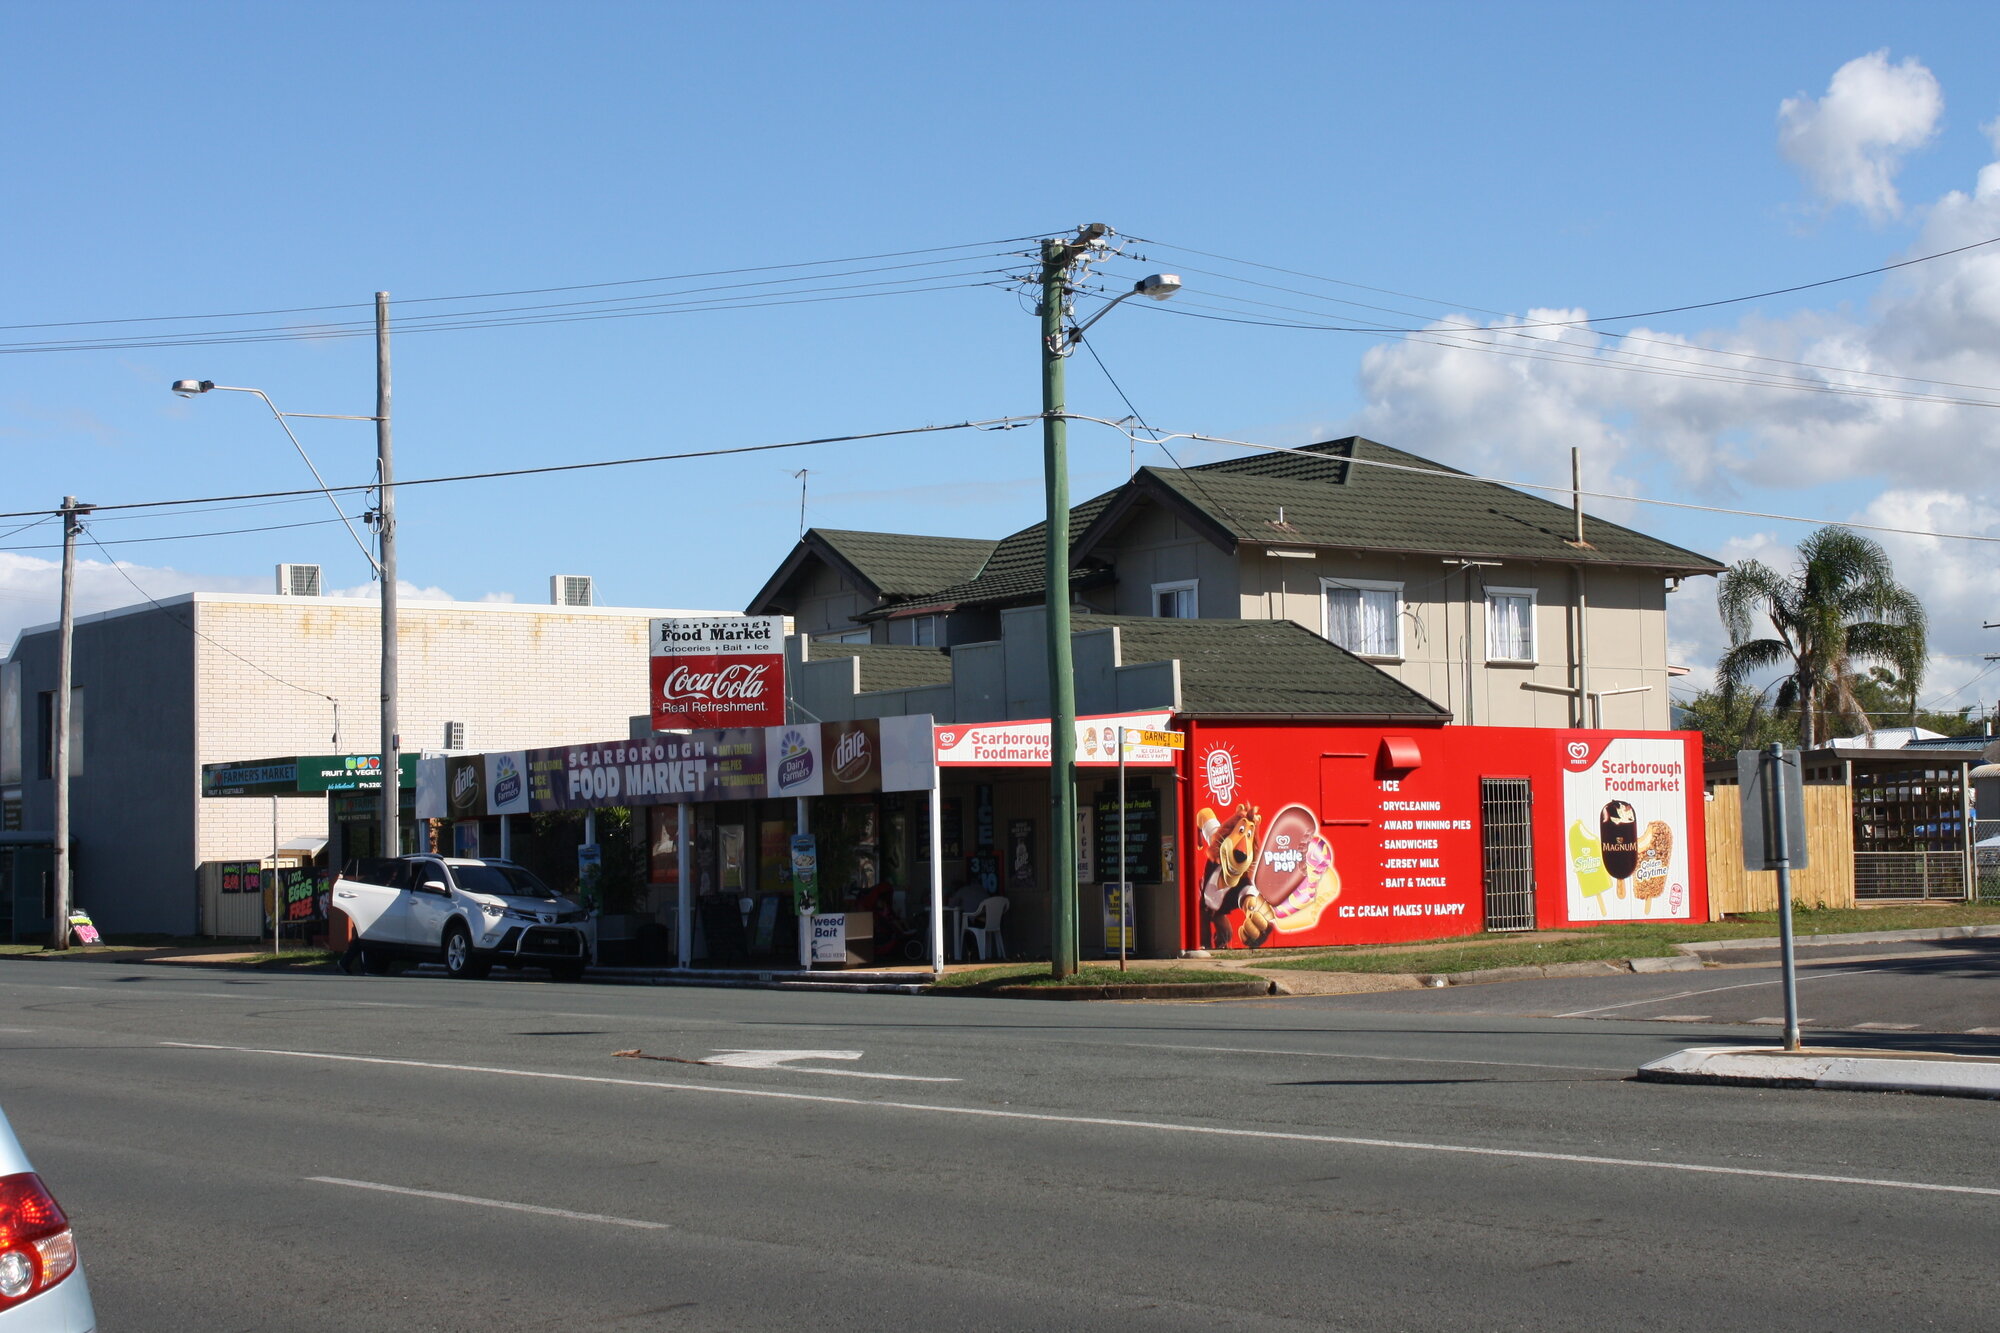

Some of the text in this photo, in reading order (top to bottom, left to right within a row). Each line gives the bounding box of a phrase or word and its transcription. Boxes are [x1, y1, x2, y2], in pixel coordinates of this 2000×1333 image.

[662, 620, 771, 629] Scarborough
[661, 628, 771, 641] Food Market
[723, 644, 742, 652] Bait
[754, 643, 769, 651] Ice
[663, 664, 770, 700] Coca-Cola
[662, 702, 688, 713] Real
[971, 731, 1050, 747] Scarboroug
[1144, 731, 1183, 744] GARNET ST
[569, 742, 705, 768] SCARBOROUGH
[837, 729, 865, 770] dare
[974, 746, 1052, 760] Foodmarke
[786, 759, 806, 773] Dairy
[1601, 760, 1682, 777] Scarborough
[261, 766, 295, 780] MARKET
[321, 769, 344, 777] FRUIT
[568, 759, 707, 800] FOOD MARKET
[782, 767, 810, 783] Farmers
[500, 780, 515, 792] Dairy
[1382, 780, 1400, 792] ICE
[1604, 777, 1680, 791] Foodmarket
[498, 786, 519, 801] Farmers
[1383, 801, 1441, 811] DRYCLEANING
[1384, 820, 1472, 830] AWARD WINNING PIES
[1384, 839, 1438, 849] SANDWICHES
[1602, 842, 1637, 852] MAGNUM
[1264, 849, 1303, 865] paddle
[1385, 858, 1440, 868] JERSEY MILK
[1274, 861, 1296, 873] pop
[1641, 860, 1661, 870] Golden
[1636, 867, 1667, 880] Gaytime
[1385, 877, 1447, 888] BAIT & TACKLE
[288, 878, 312, 904] EGGS
[289, 896, 313, 921] FREE
[1339, 903, 1465, 917] ICE CREAM MAKES U HAPPY
[815, 927, 838, 938] Bait
